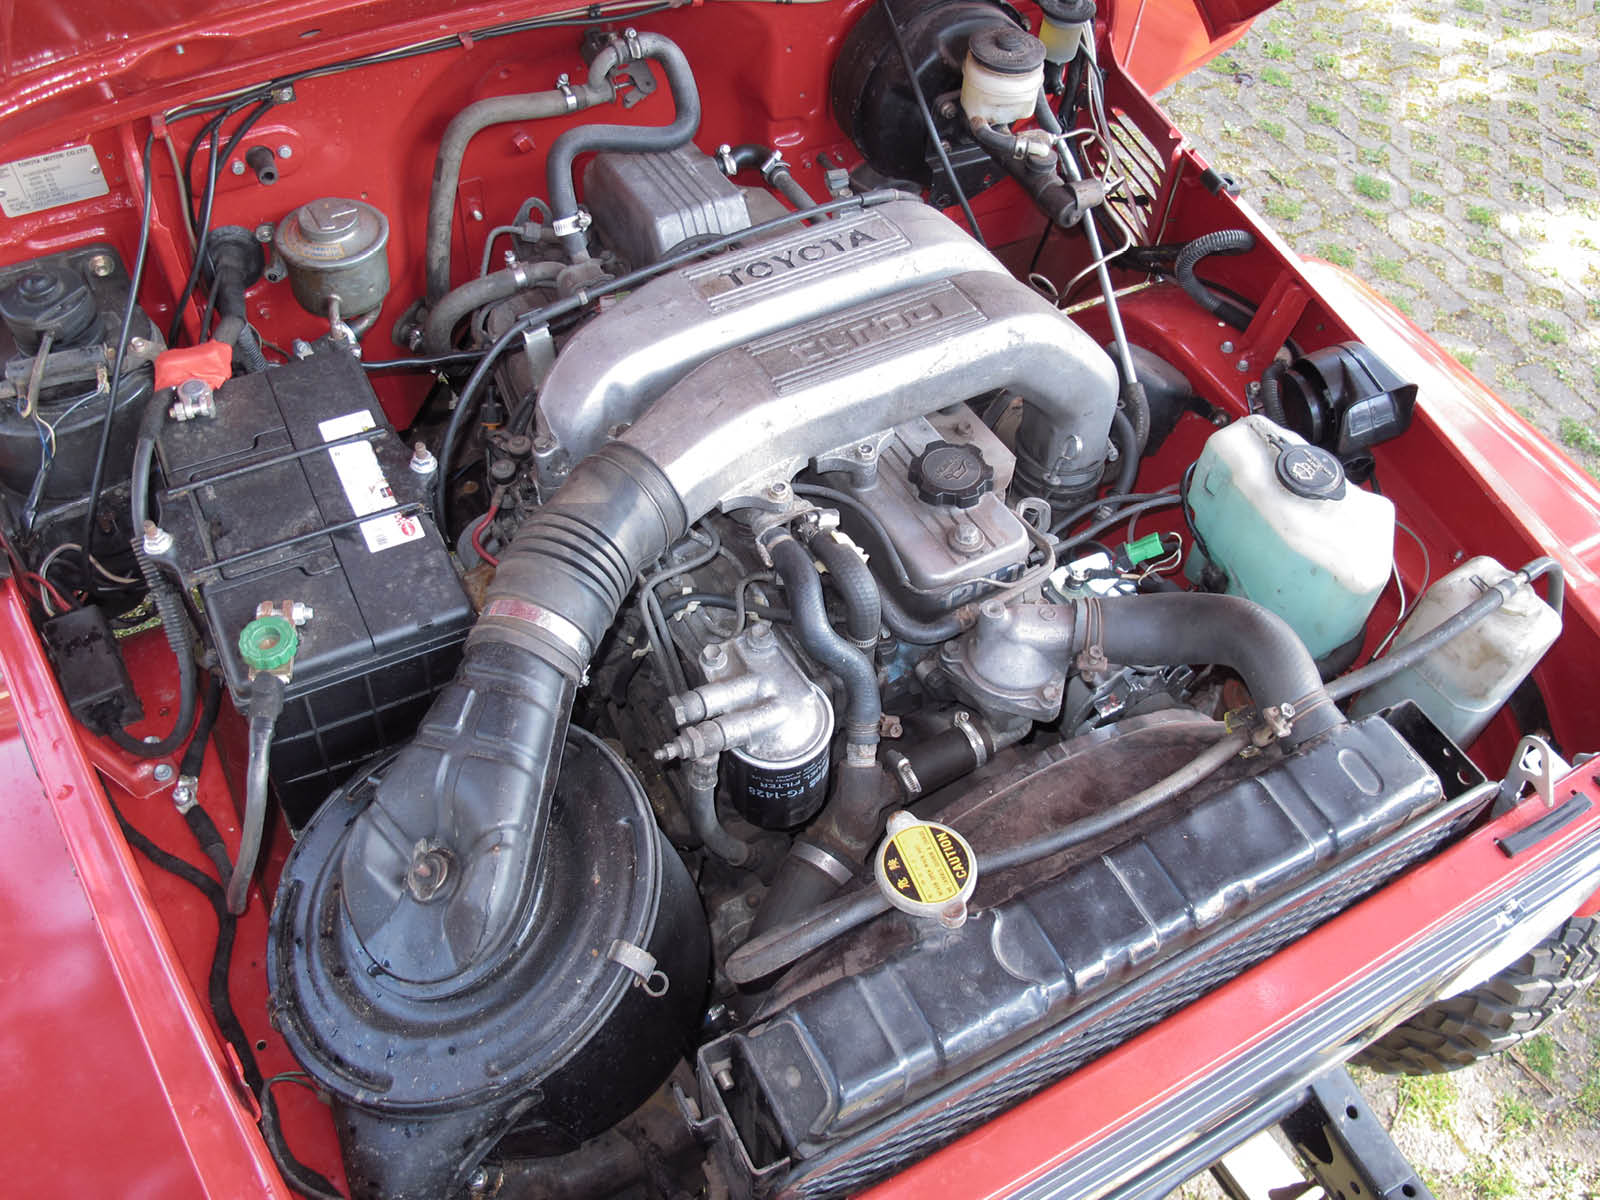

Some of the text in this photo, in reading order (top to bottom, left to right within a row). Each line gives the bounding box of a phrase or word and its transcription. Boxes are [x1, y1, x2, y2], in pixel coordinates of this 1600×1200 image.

[718, 229, 876, 286] TOYOTA
[760, 780, 801, 789] FILTER
[936, 832, 967, 879] CAUTION
